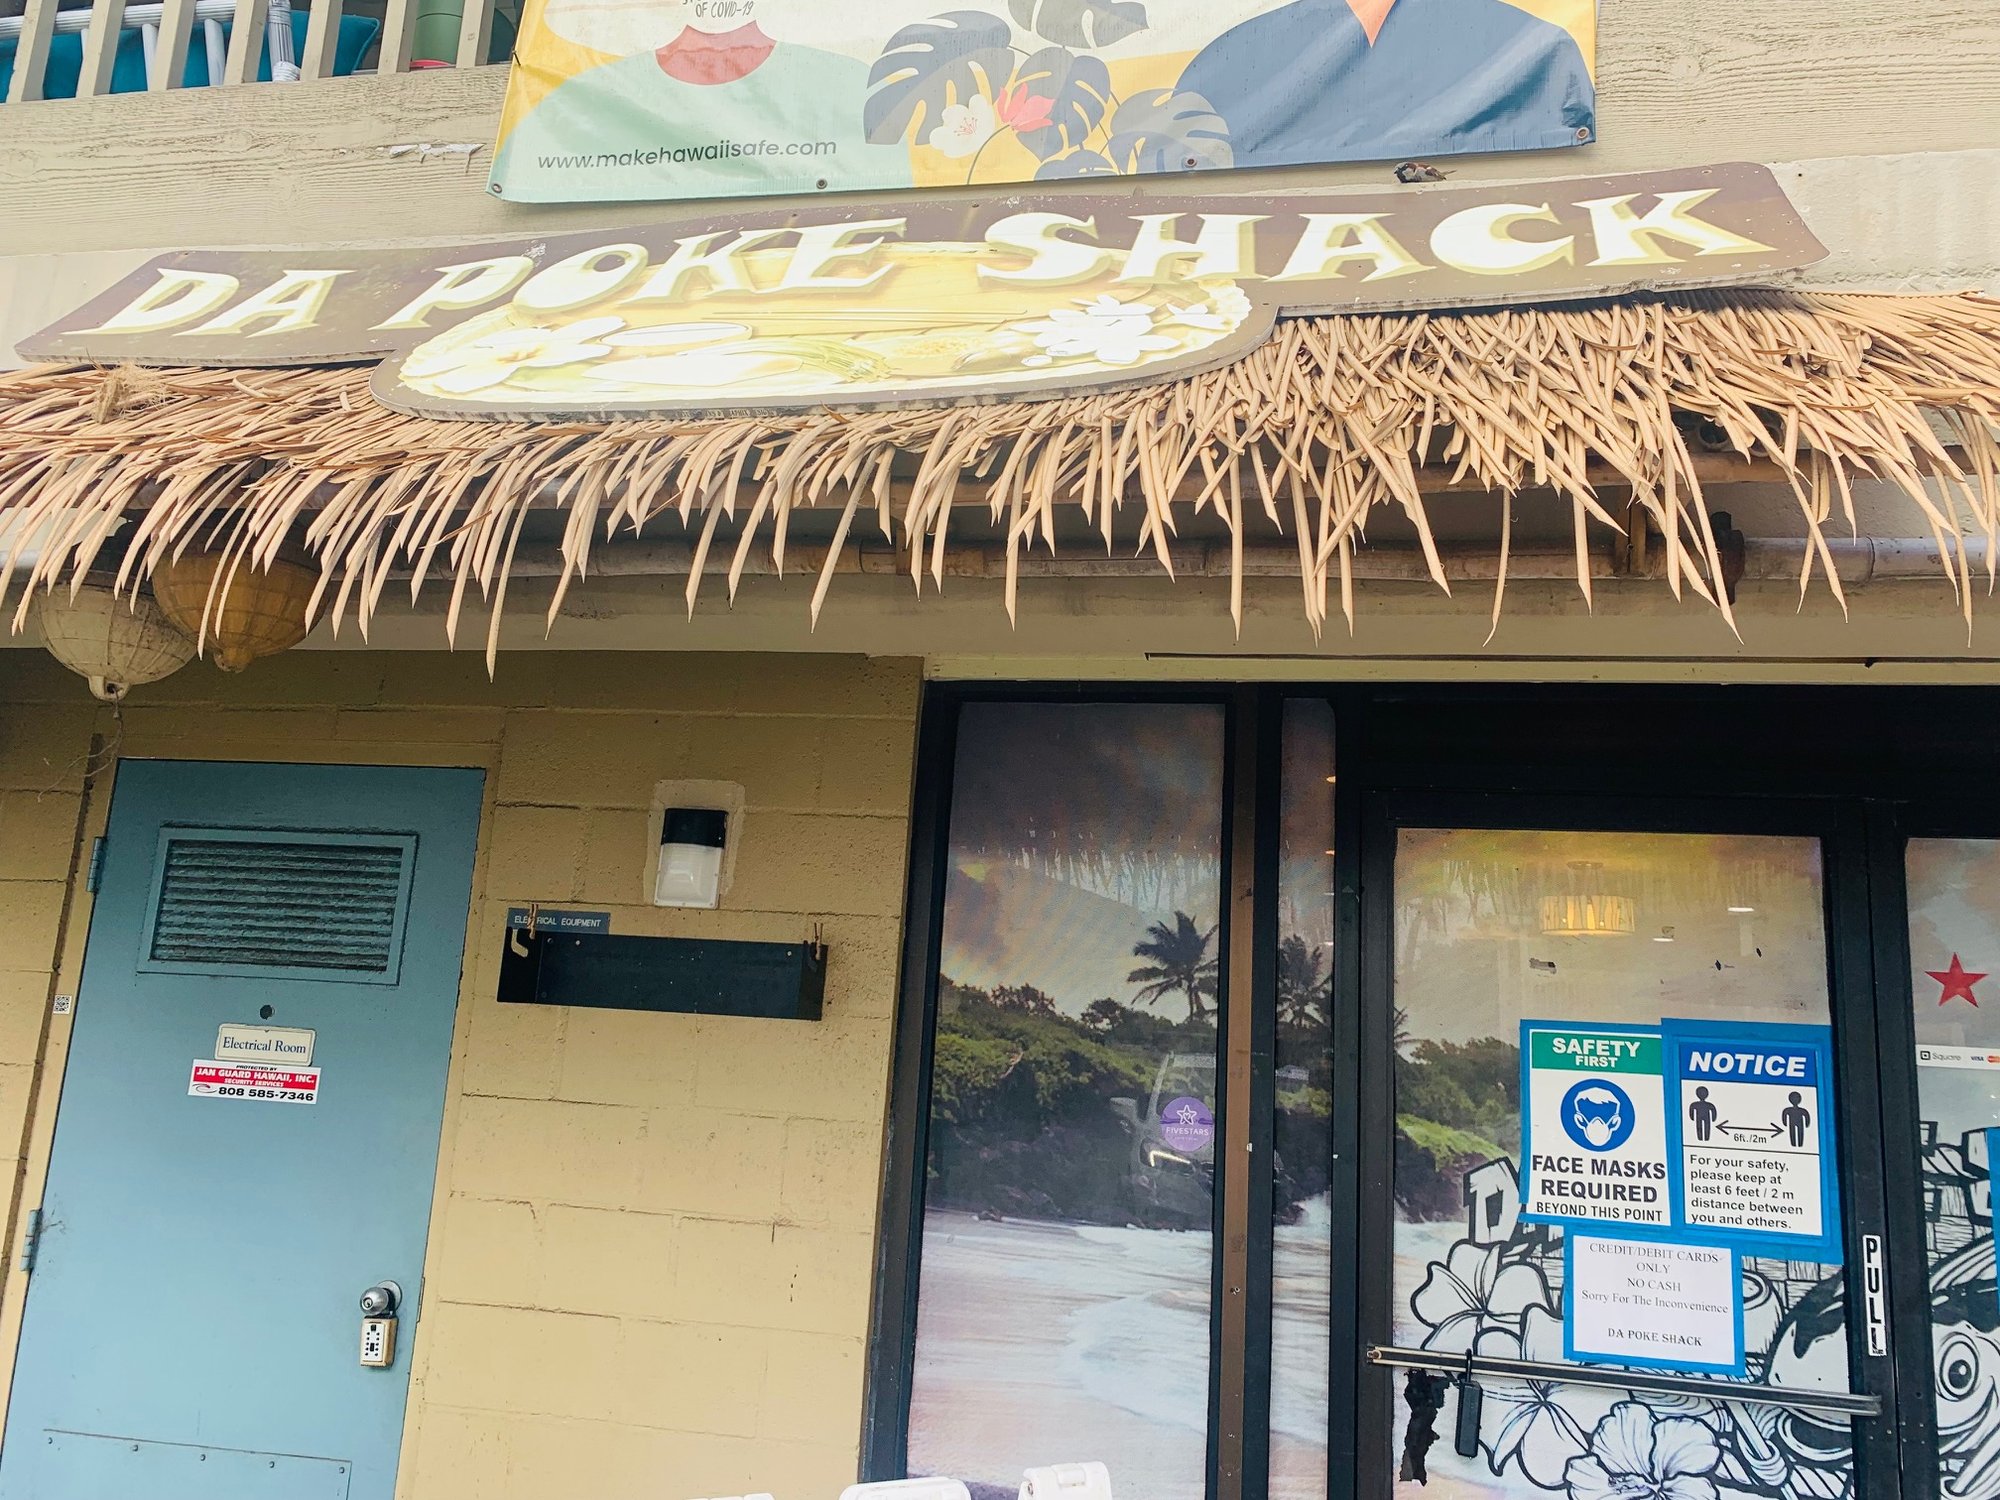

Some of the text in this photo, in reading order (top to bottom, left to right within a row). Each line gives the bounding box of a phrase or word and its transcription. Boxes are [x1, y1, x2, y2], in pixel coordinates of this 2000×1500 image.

[695, 1, 754, 18] OF COVID-19
[538, 140, 837, 169] www.makehawaiisafe.com
[65, 187, 1778, 337] DA POKE SHACK
[514, 916, 601, 927] ELERICAL EQUIPMENT
[223, 1037, 307, 1054] Electrical Room
[1552, 1038, 1641, 1057] SAFETY
[1575, 1056, 1618, 1068] FIRST
[1689, 1051, 1807, 1078] NOTICE
[1932, 1053, 1961, 1062] Square
[196, 1068, 315, 1083] JAN GUARD HAWAII, INC.
[224, 1078, 284, 1088] SECURITY SERVICES
[218, 1087, 314, 1101] 808 585-7346
[1166, 1127, 1209, 1136] FIVESTARS
[1532, 1155, 1666, 1180] FACE MASKS
[1690, 1154, 1789, 1172] For your safety,
[1690, 1169, 1782, 1185] please keep at
[1541, 1179, 1658, 1203] REQUIRED
[1690, 1183, 1721, 1195] least
[1724, 1185, 1732, 1195] 6
[1736, 1186, 1760, 1198] feet
[1771, 1188, 1778, 1198] 2
[1782, 1190, 1794, 1200] m
[1536, 1202, 1663, 1222] BEYOND THIS POINT
[1691, 1198, 1803, 1215] distance between
[1691, 1213, 1792, 1229] you and others.
[1589, 1243, 1719, 1264] CREDIT/DEBIT CARDS
[1636, 1263, 1671, 1274] ONLY
[1627, 1278, 1681, 1292] NO CASH
[1581, 1290, 1728, 1314] Sorry For The Inconvenience
[1866, 1238, 1883, 1350] PULL
[1608, 1328, 1703, 1347] DA POKE SHACK
